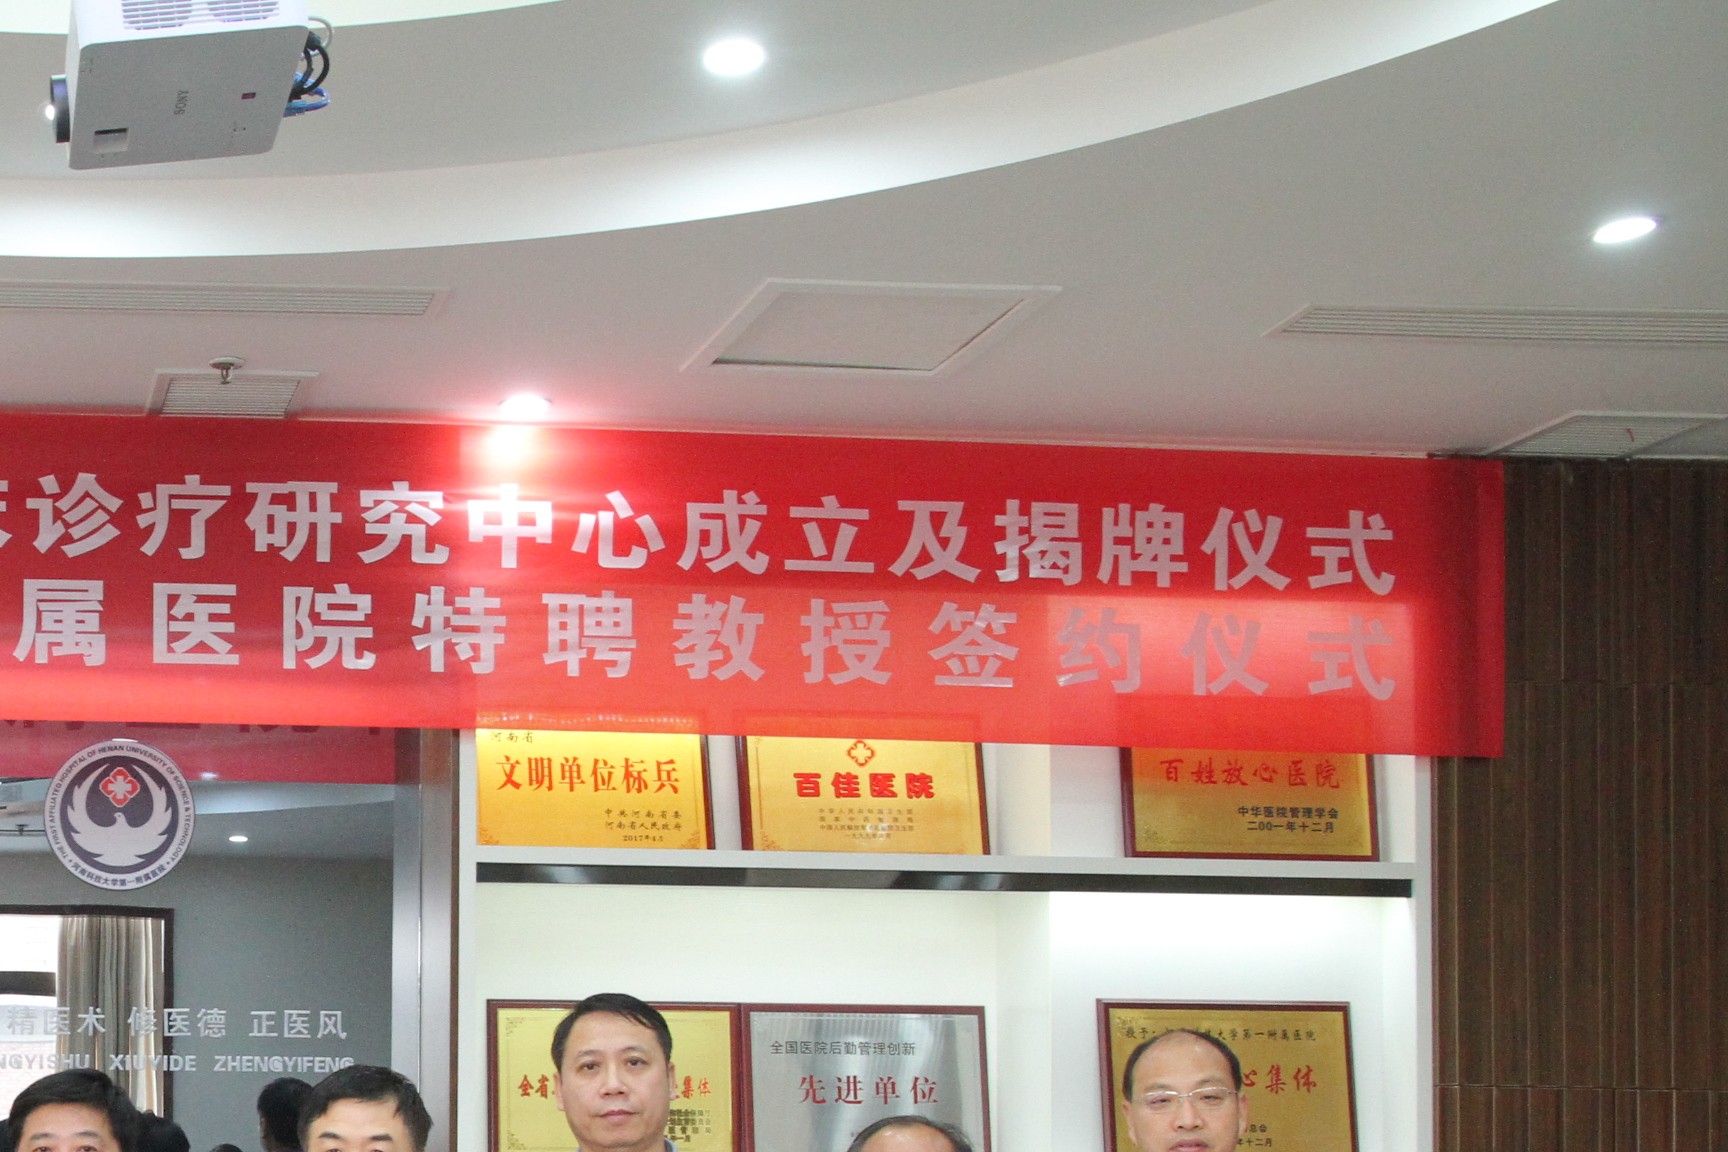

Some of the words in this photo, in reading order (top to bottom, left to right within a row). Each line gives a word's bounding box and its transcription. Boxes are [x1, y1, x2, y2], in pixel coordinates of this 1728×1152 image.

[173, 90, 190, 115] SONY
[490, 730, 534, 744] 河南省
[98, 745, 125, 753] HENAN
[126, 745, 168, 767] UNIVERSITY
[495, 754, 681, 795] 文明单位标兵
[792, 771, 935, 799] 百佳医院
[1159, 756, 1340, 789] 百姓放心医院
[1237, 805, 1340, 819] 中华医院管理学会
[72, 861, 169, 887] 河南科技大学第一附属医院
[7, 1005, 107, 1037] 精医术
[127, 1006, 227, 1037] 修医德
[248, 1008, 349, 1040] 正医风
[769, 1040, 916, 1056] 全国医院后勤管理创新
[109, 1054, 197, 1072] XIUYIDE
[213, 1055, 355, 1074] ZHENGYIFENG
[798, 1074, 938, 1105] 先进单位
